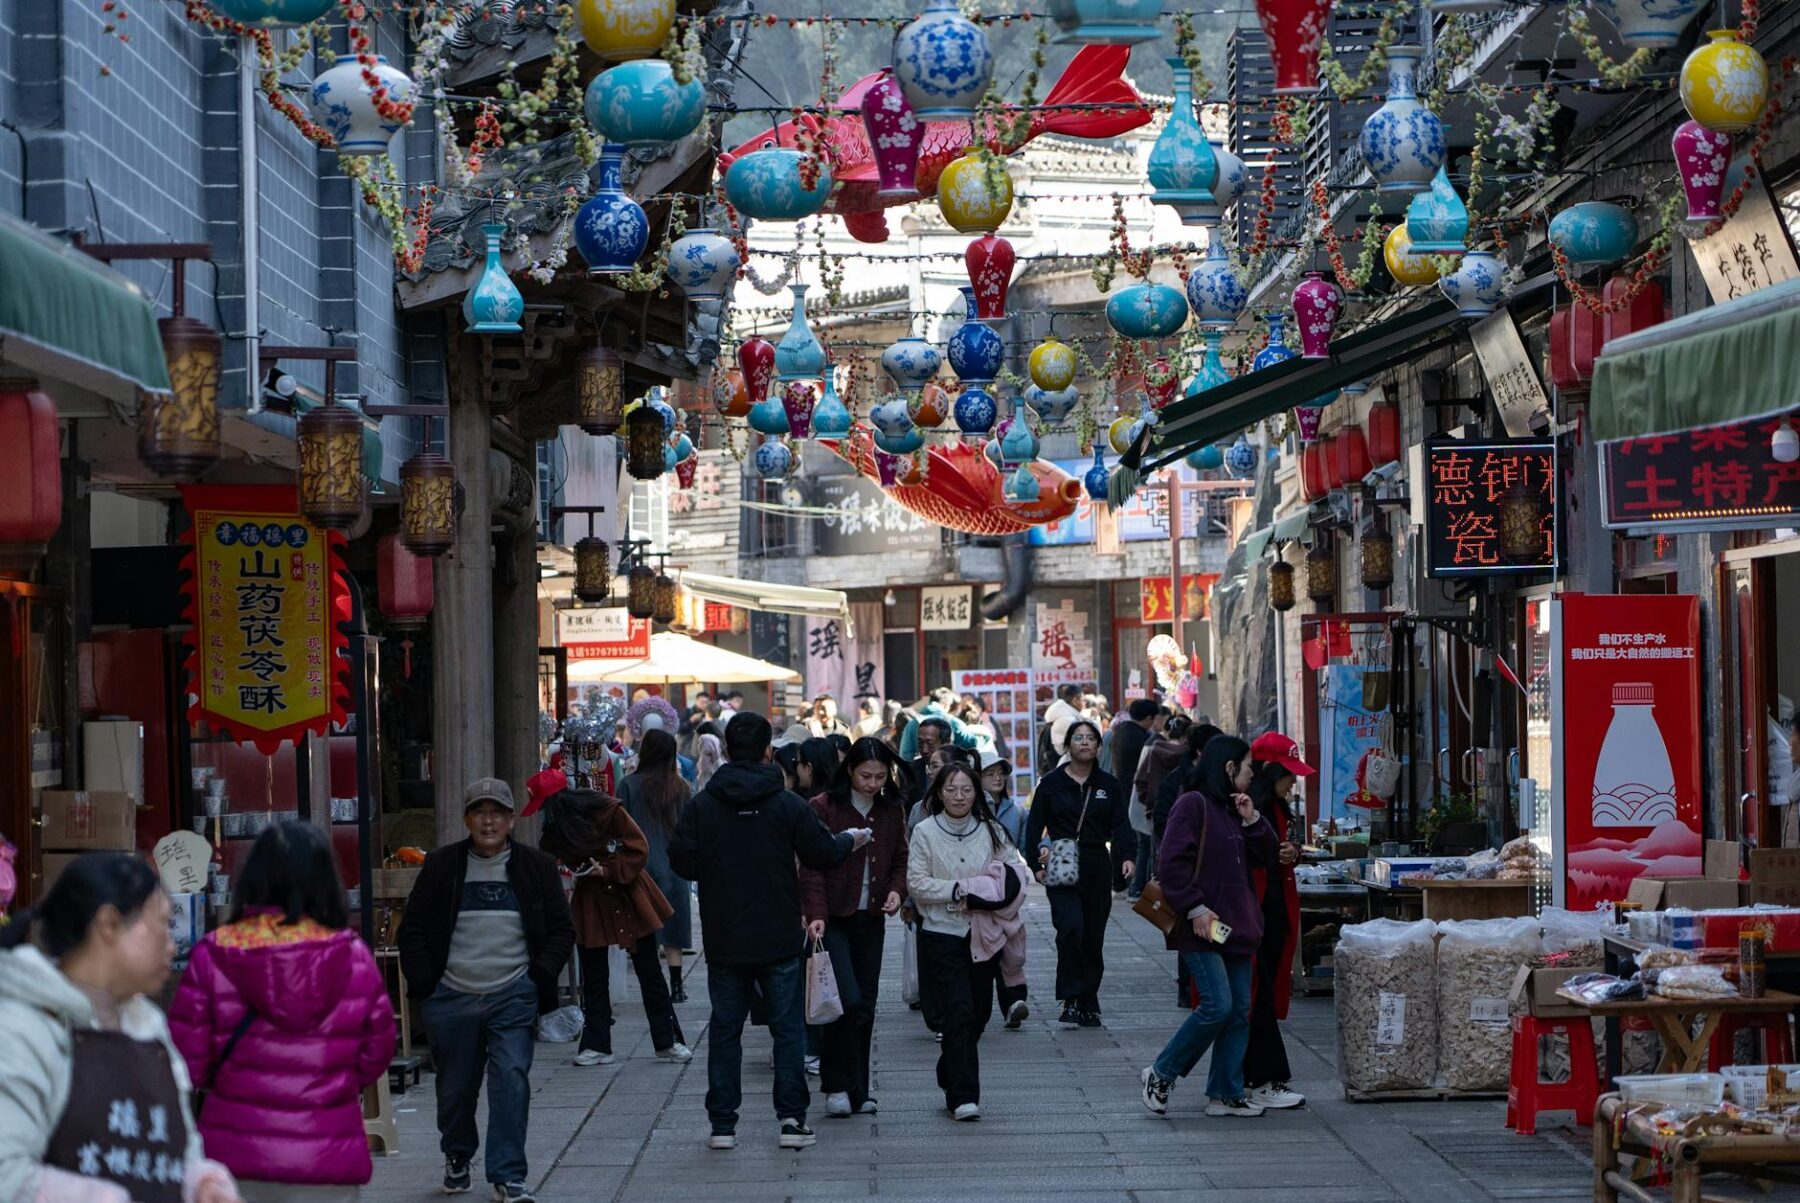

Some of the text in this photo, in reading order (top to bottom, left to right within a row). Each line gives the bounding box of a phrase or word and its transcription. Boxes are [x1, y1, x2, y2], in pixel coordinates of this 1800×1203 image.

[1623, 460, 1800, 510] 土特产
[216, 522, 308, 547] 幸福瑶里
[236, 550, 288, 714] 山药茯苓酥
[305, 562, 322, 698] 传统手工 现做现卖
[1598, 633, 1667, 646] 我们不生产水
[1571, 647, 1695, 660] 我们只是大自然的搬运工
